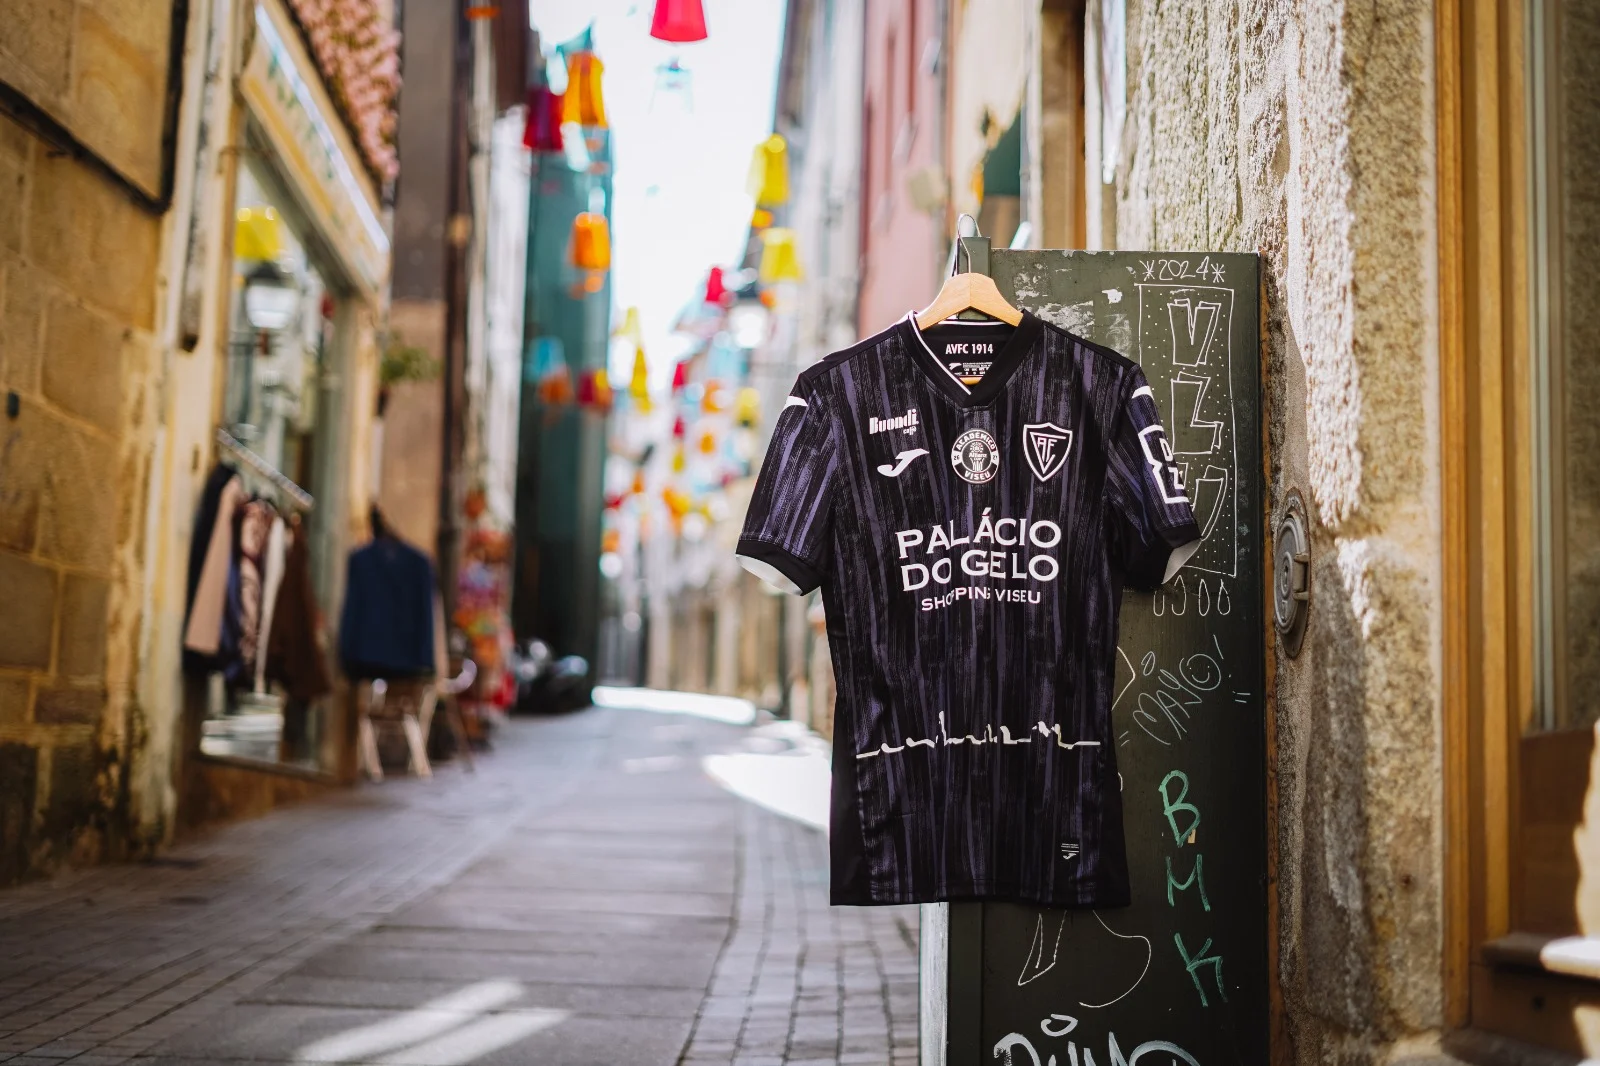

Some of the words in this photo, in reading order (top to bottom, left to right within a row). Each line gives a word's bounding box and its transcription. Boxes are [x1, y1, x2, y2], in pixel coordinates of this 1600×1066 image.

[945, 343, 969, 355] AVFC
[971, 343, 993, 355] 1914
[964, 470, 991, 481] VISEU
[894, 506, 1062, 559] PALÁCIO
[900, 557, 952, 592] DO
[960, 549, 1060, 582] GELO
[995, 588, 1041, 604] VISEU
